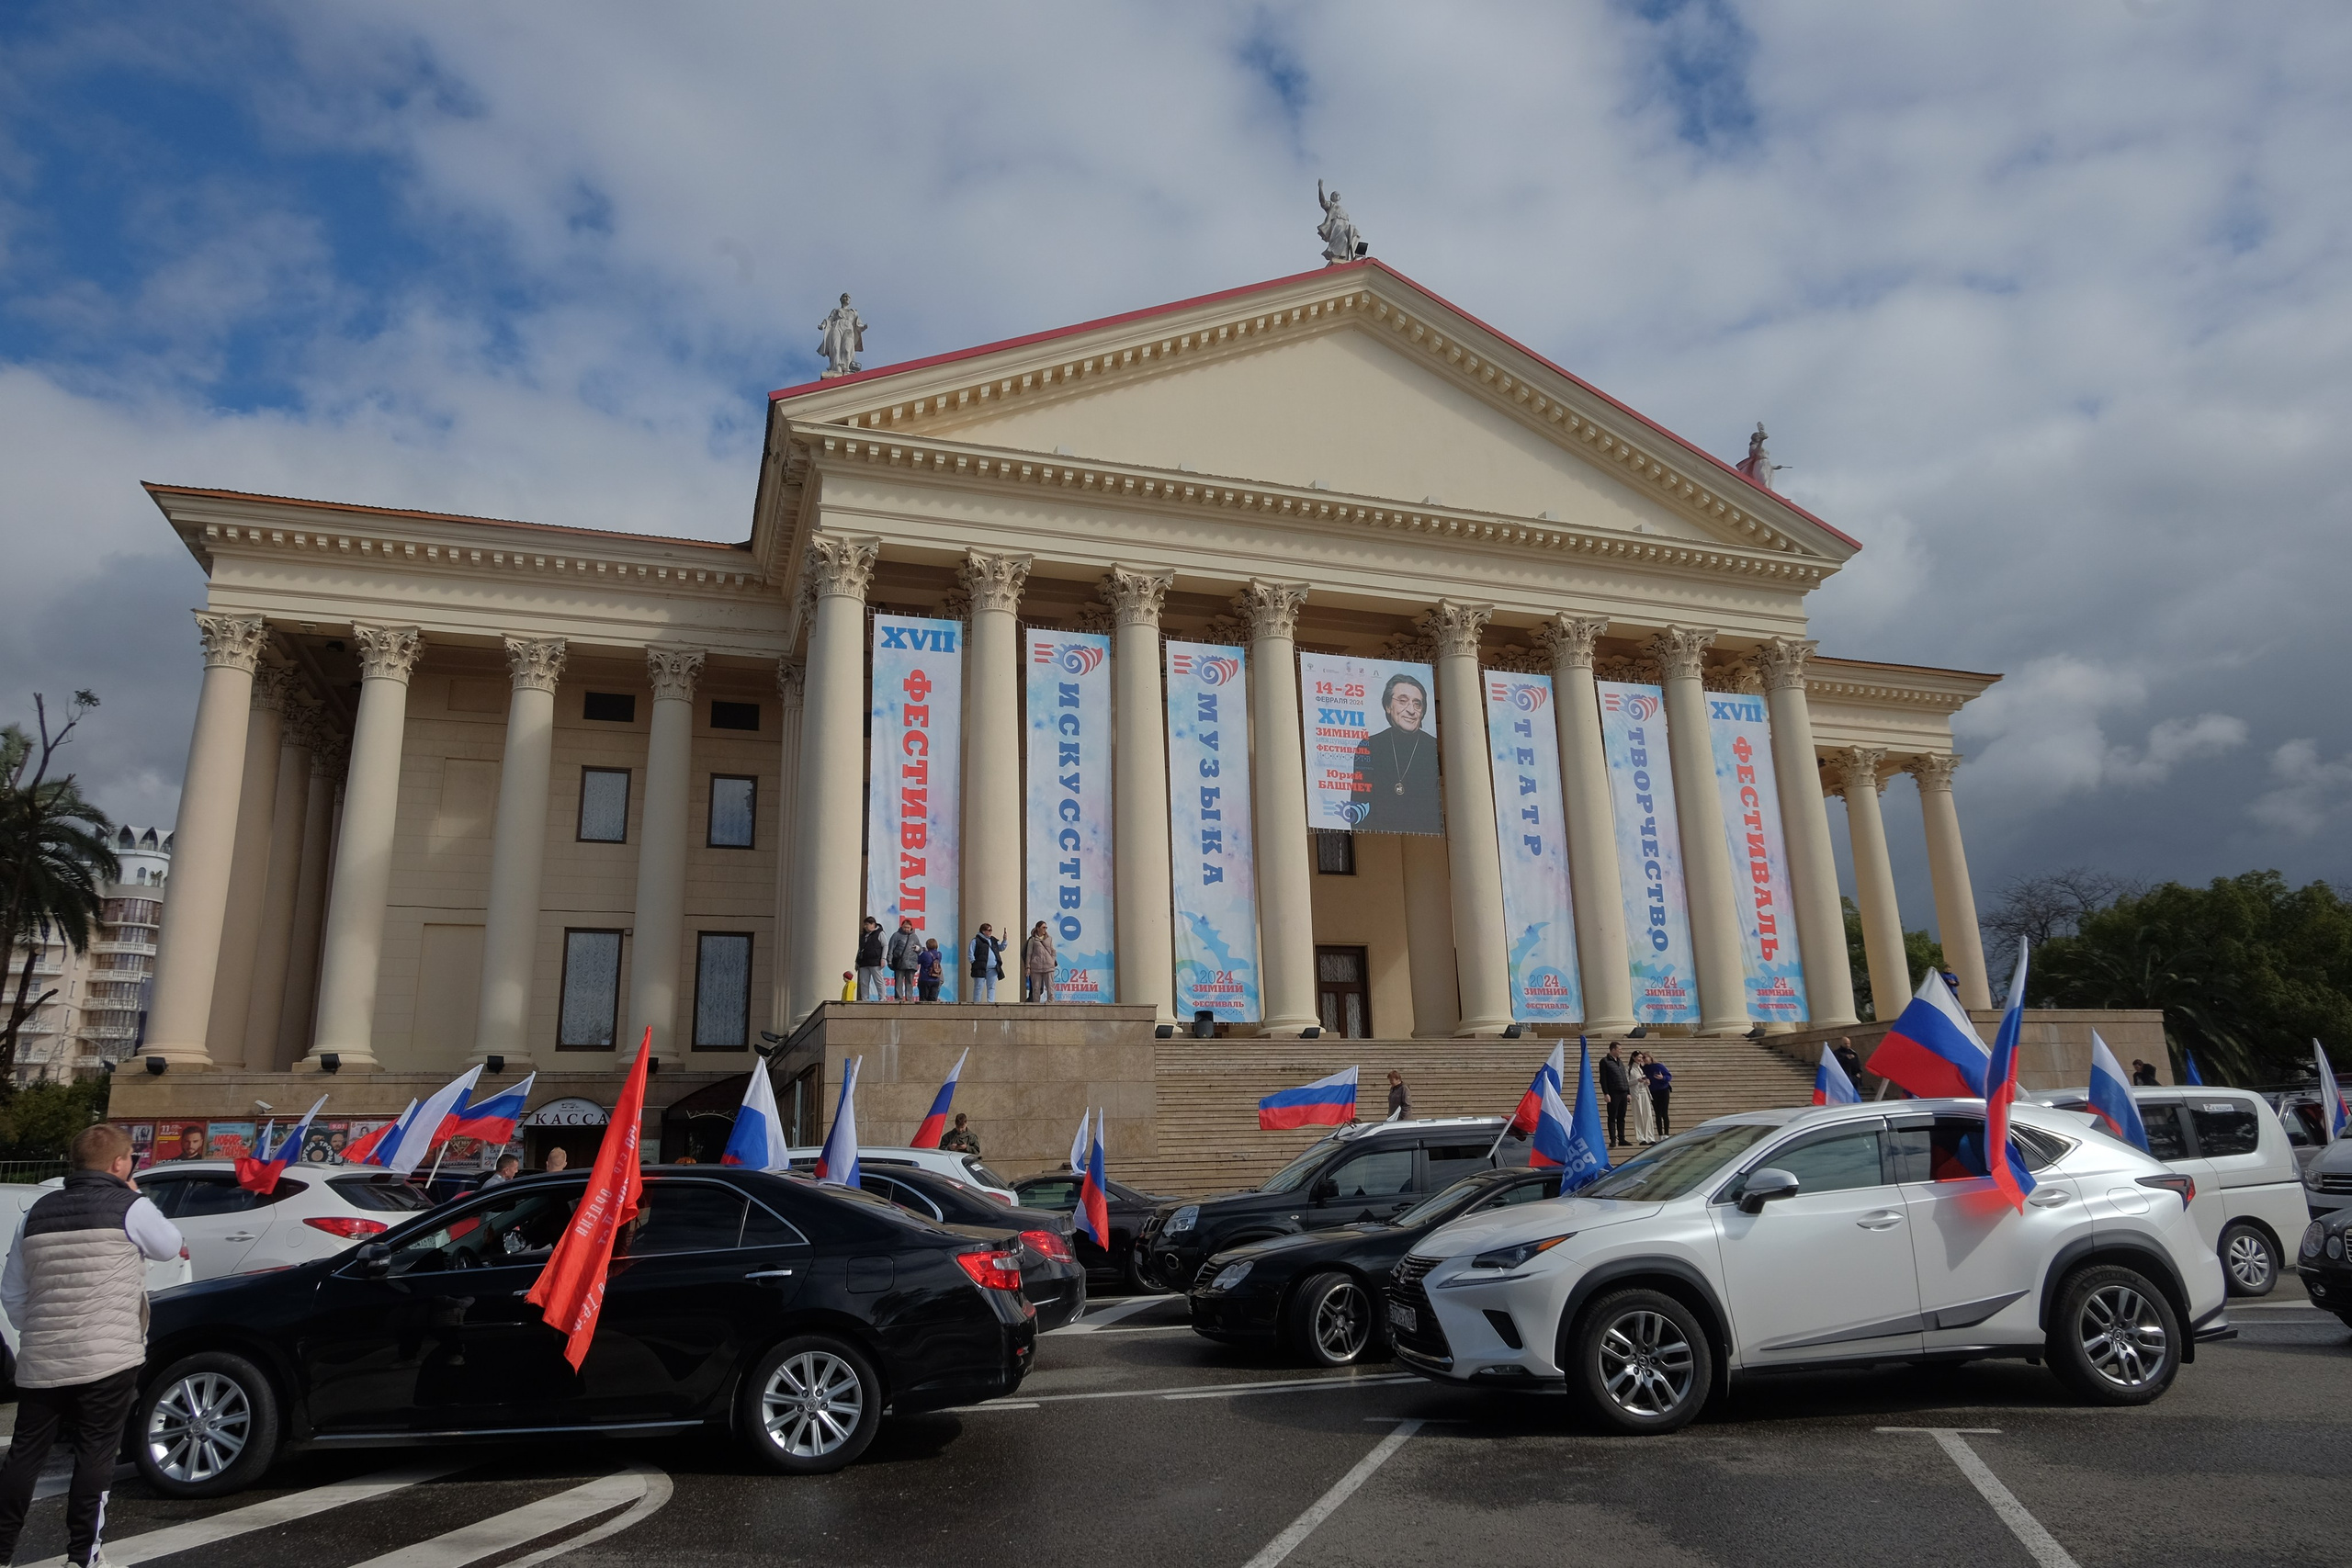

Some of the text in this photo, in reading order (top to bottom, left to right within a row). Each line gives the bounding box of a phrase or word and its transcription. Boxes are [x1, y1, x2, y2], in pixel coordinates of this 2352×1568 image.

[880, 626, 956, 653] XVII
[1316, 695, 1348, 705] ФЕВРАЛЯ
[1318, 708, 1366, 727] XVII
[1711, 701, 1763, 723] XVII
[1316, 727, 1370, 739] ЗИМНИЙ
[1317, 744, 1371, 755] ФЕСТИВАЛЬ
[1327, 769, 1363, 780] Юрий
[1197, 693, 1224, 886] МУЗЫКА
[1318, 780, 1373, 793] БАШМЕТ
[1514, 718, 1543, 856] ТЕАТР
[1057, 682, 1082, 942] ИСКУССТВО
[1627, 727, 1669, 953] ТВОРЧЕСТВО
[1732, 736, 1779, 962] ФЕСТИВАЛЬ
[1054, 968, 1089, 983] 2024
[1199, 970, 1234, 984] 2024
[1529, 974, 1559, 987] 2024
[1650, 976, 1678, 988] 2024
[1760, 976, 1787, 988] 2024
[1054, 981, 1099, 992] ИМНИЙ
[1193, 982, 1244, 993] ЗИМНИЙ
[1524, 986, 1568, 996] ЗИМНИЙ
[1645, 987, 1686, 997] ЗИМНИЙ
[534, 1113, 609, 1125] КАССА
